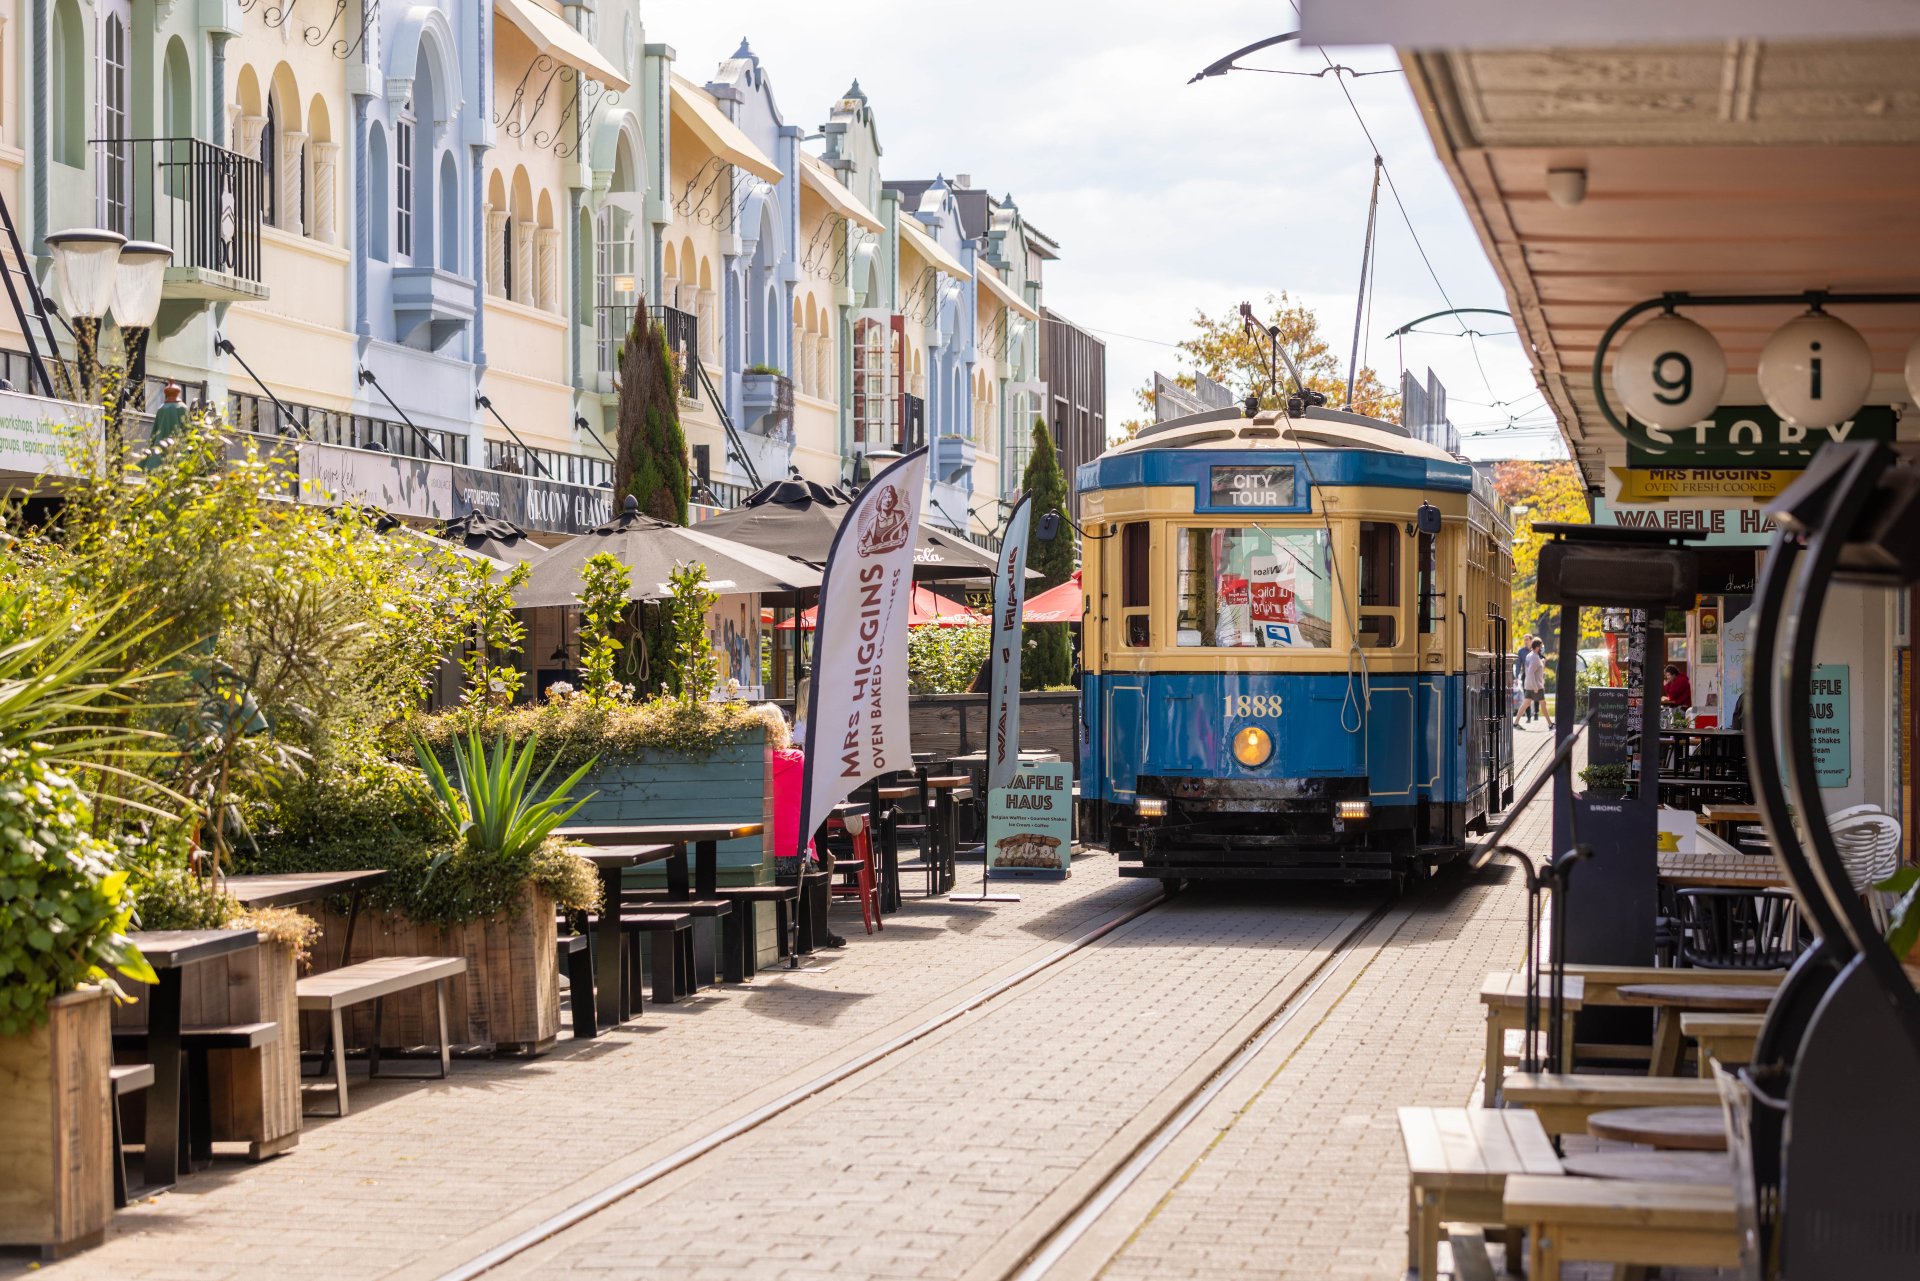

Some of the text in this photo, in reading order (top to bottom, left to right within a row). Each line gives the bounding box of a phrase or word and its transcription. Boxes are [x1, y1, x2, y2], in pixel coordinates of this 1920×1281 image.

[1233, 474, 1272, 489] CITY
[1649, 469, 1772, 480] MRS HIGGINS
[1644, 481, 1777, 492] OVEN FRESH COOKIES
[463, 487, 500, 507] OPTOMETRISTS
[527, 487, 570, 524] GROOVY
[1229, 491, 1277, 505] TOUR
[1614, 510, 1725, 533] WAFFLE
[840, 564, 884, 777] MRS HIGGINS
[870, 664, 882, 719] BAKED
[1223, 694, 1283, 717] 1888
[872, 724, 886, 769] OVEN
[1817, 736, 1841, 744] Shakes
[1006, 794, 1053, 810] HAUS
[1590, 804, 1622, 812] BROMIC
